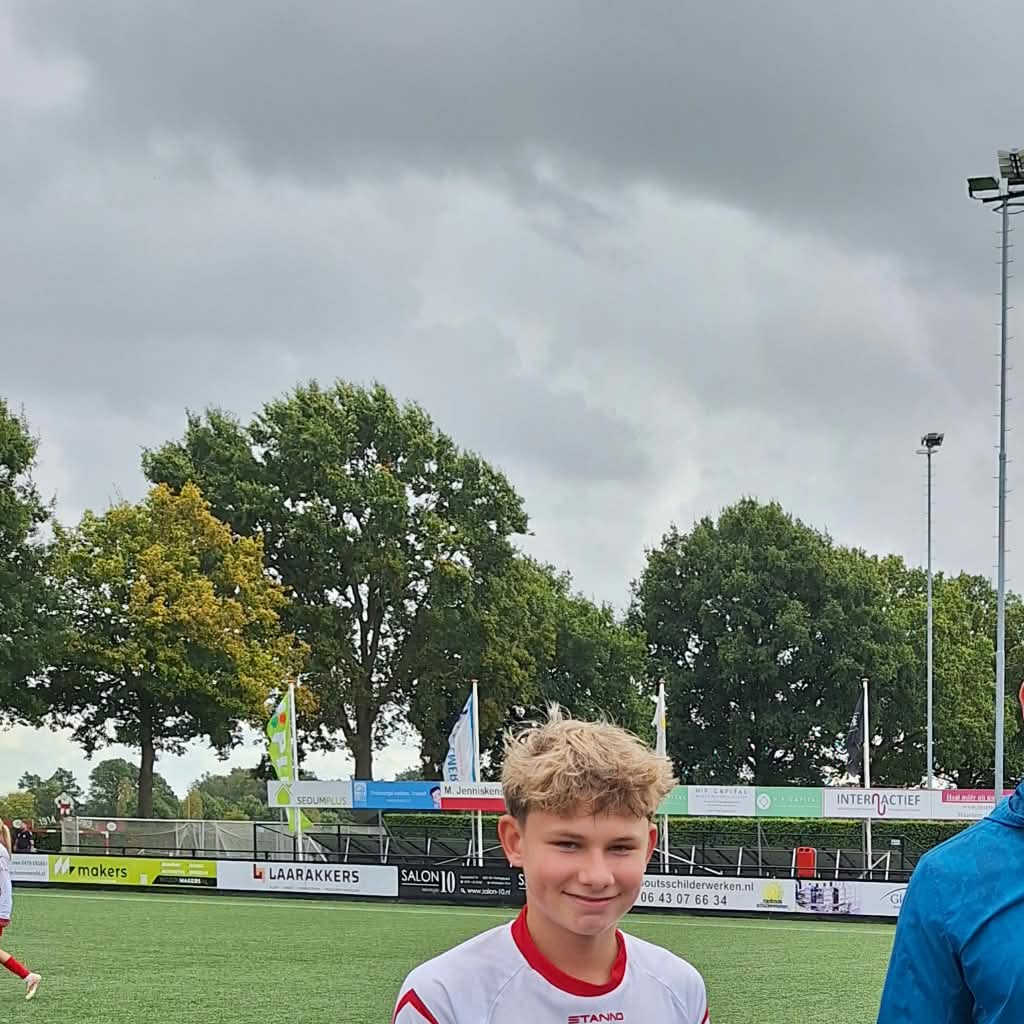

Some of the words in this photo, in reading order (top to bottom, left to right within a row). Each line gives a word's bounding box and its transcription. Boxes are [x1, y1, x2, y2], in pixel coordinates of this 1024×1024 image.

[296, 796, 347, 805] SEDUMPLUS
[78, 863, 128, 878] makers
[269, 867, 360, 883] LAARAKKERS
[401, 870, 440, 882] SALON
[440, 871, 456, 893] 10
[641, 892, 654, 903] 06
[658, 893, 672, 904] 43
[676, 893, 690, 904] 07
[695, 894, 709, 905] 66
[713, 895, 728, 906] 34
[567, 1011, 624, 1024] STANNO
